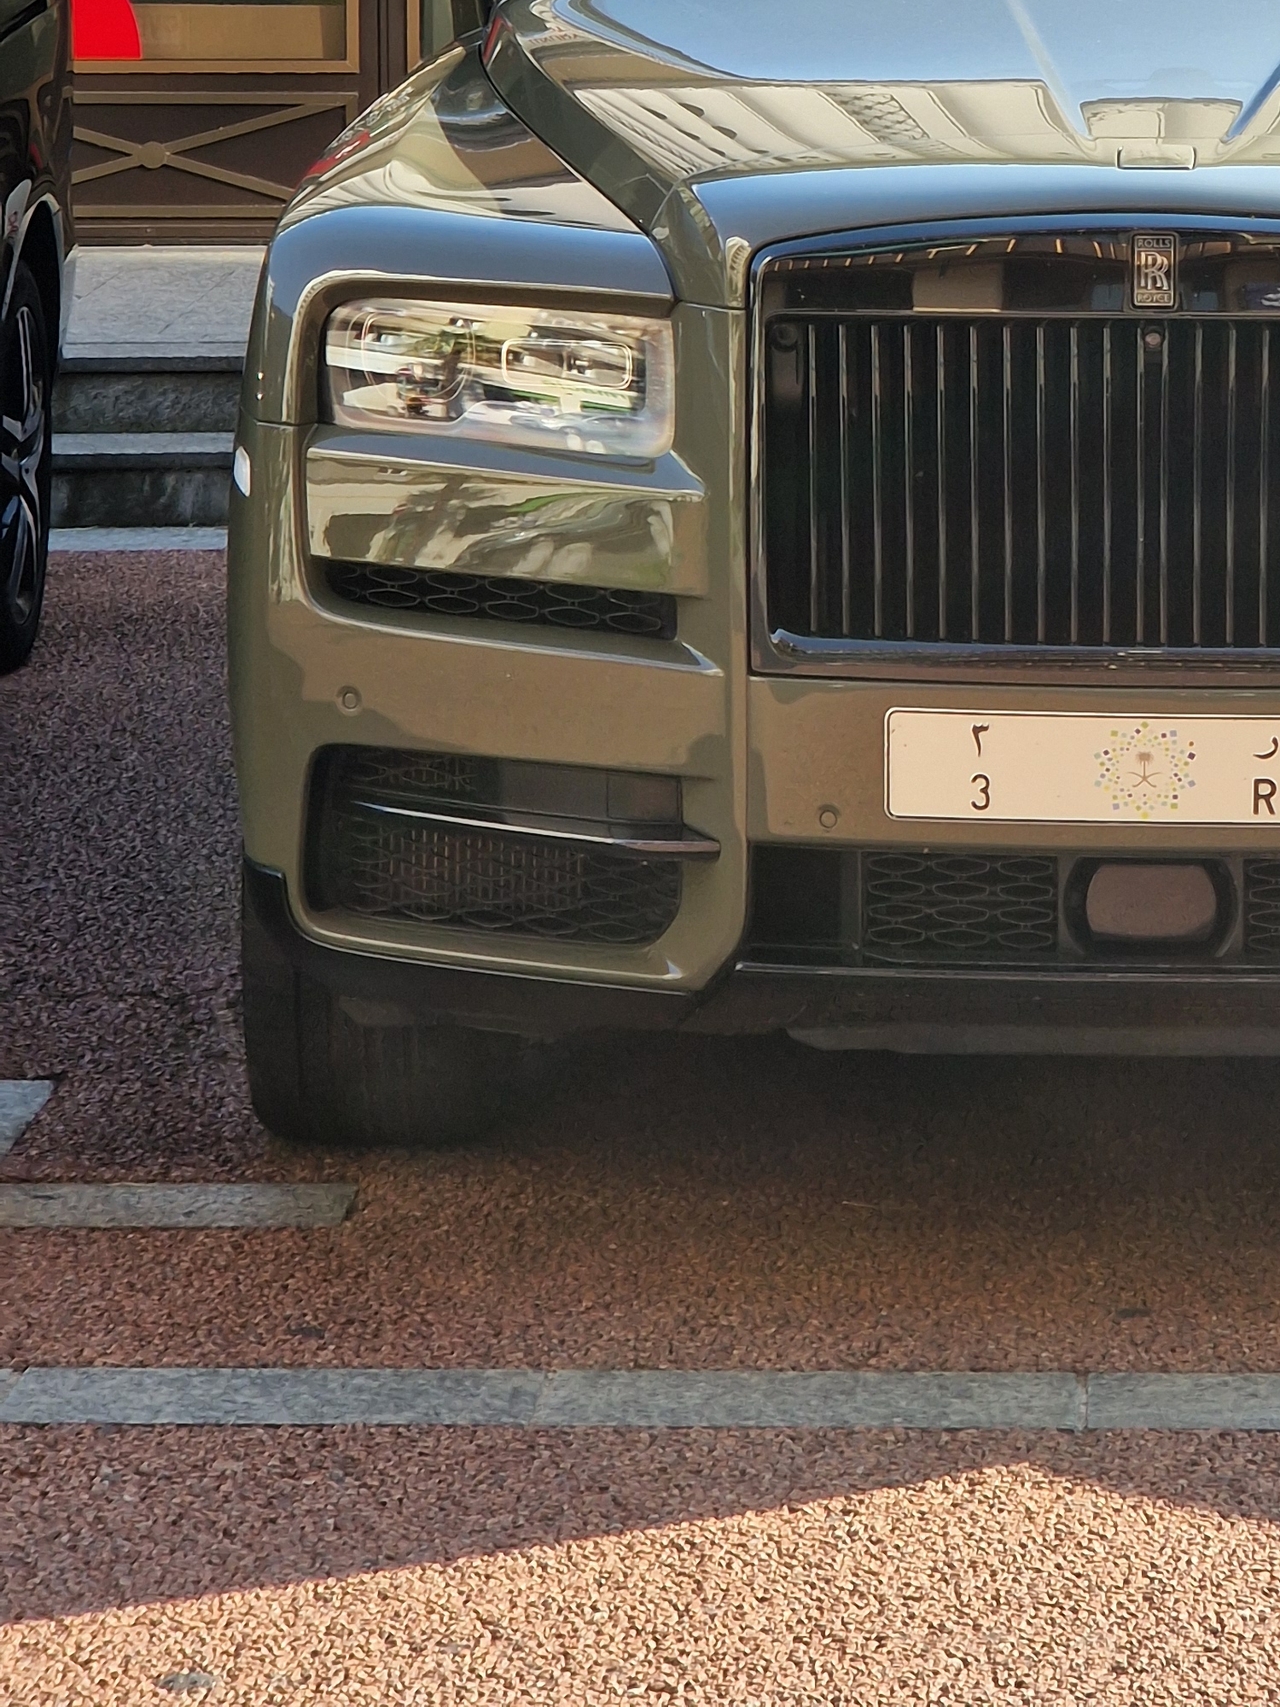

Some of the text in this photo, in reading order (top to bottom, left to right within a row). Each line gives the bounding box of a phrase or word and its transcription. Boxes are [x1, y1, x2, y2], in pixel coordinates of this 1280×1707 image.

[1138, 239, 1171, 248] ROLLS
[1137, 294, 1170, 303] ROYCE
[970, 722, 990, 758] ٣
[970, 773, 991, 812] 3
